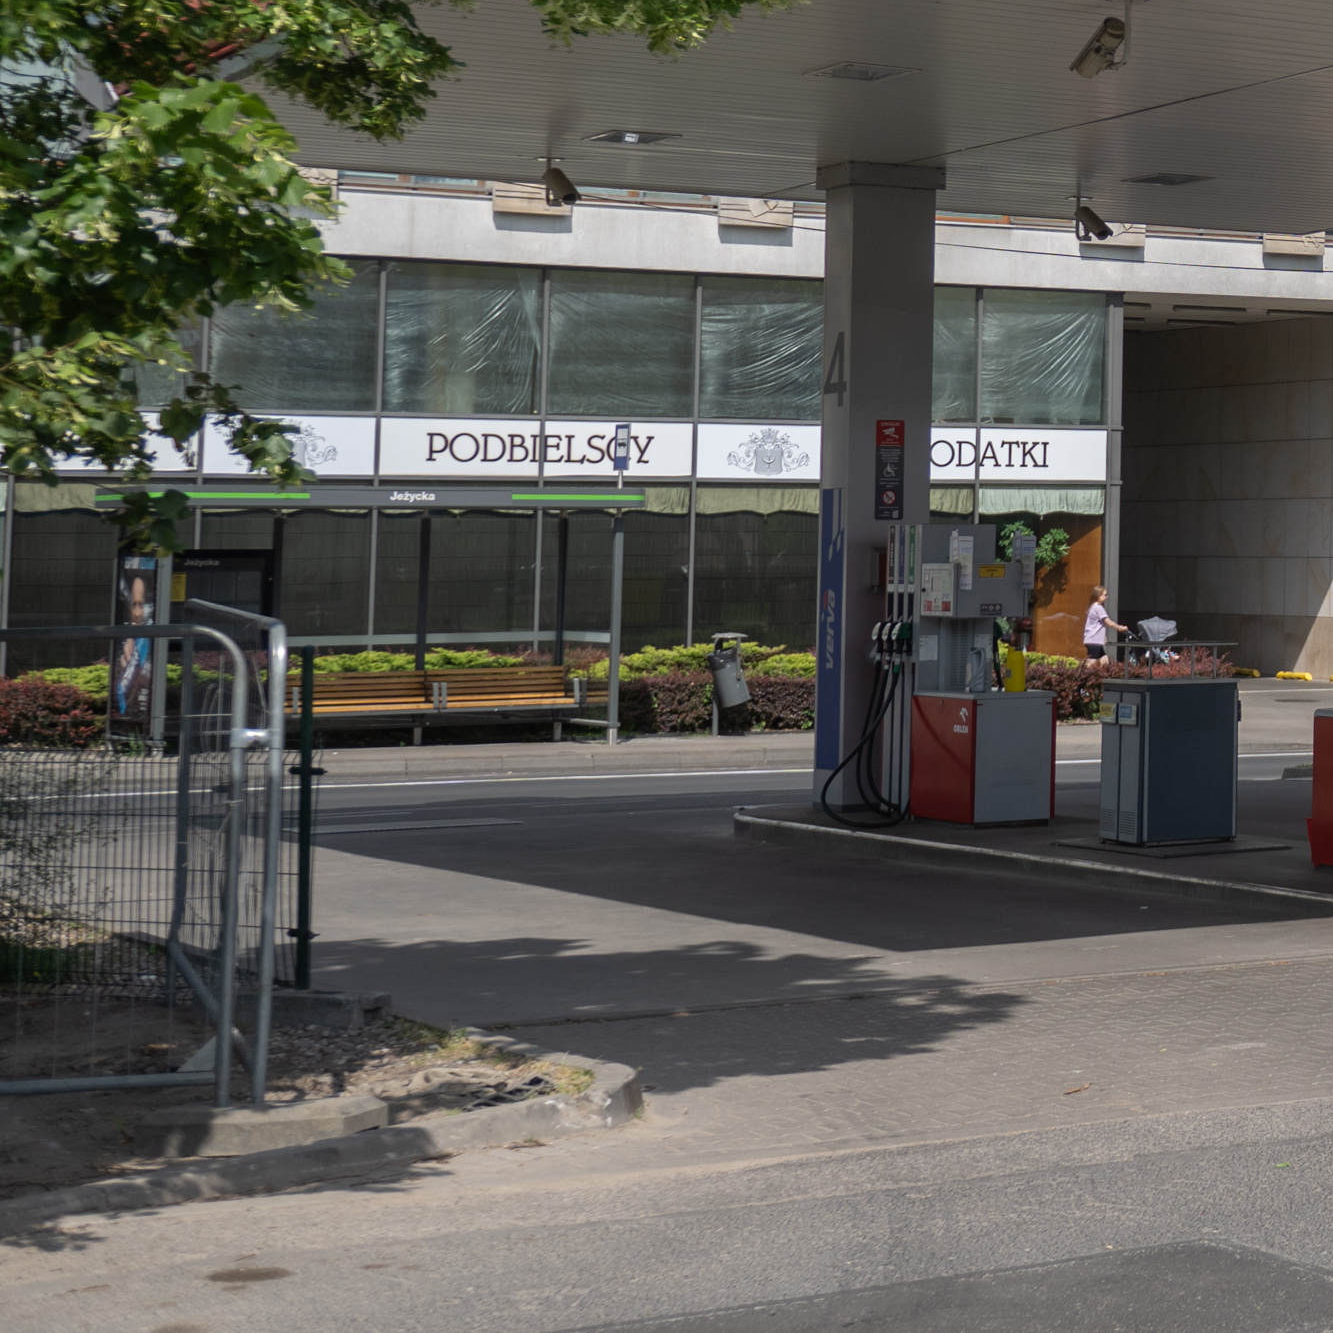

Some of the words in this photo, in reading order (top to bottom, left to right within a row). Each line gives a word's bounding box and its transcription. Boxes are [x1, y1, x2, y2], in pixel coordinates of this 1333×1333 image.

[824, 331, 847, 407] 4
[931, 440, 1050, 467] ODATKI
[389, 490, 436, 503] Jeżycka
[826, 588, 836, 669] verva
